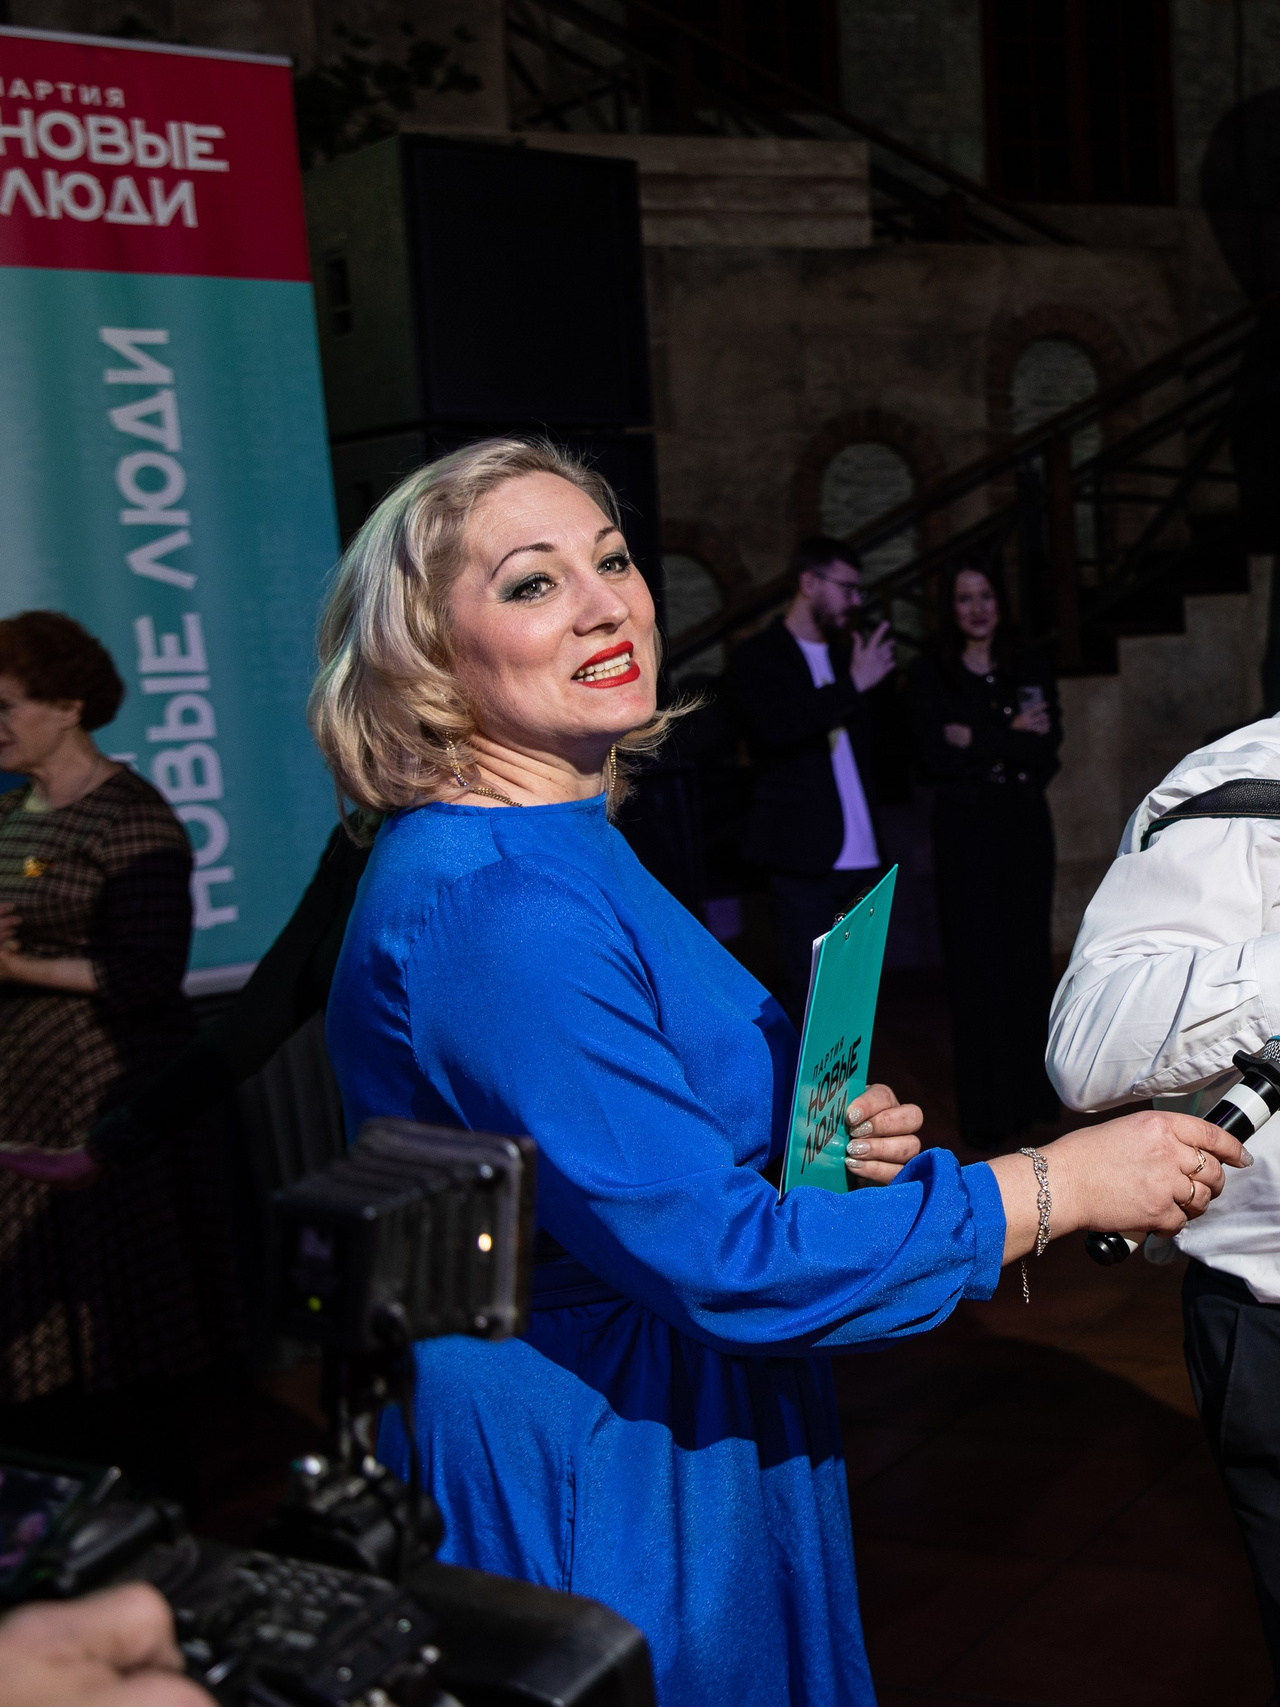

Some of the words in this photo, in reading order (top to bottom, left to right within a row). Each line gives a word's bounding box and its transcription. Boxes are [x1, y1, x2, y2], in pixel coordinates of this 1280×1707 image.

[0, 167, 199, 228] ЛЮДИ
[100, 326, 197, 590] ЛЮДИ
[807, 1035, 862, 1127] НОВЫЕ
[813, 1035, 844, 1081] ПАРТИЯ
[801, 1089, 848, 1174] ЛЮДИ
